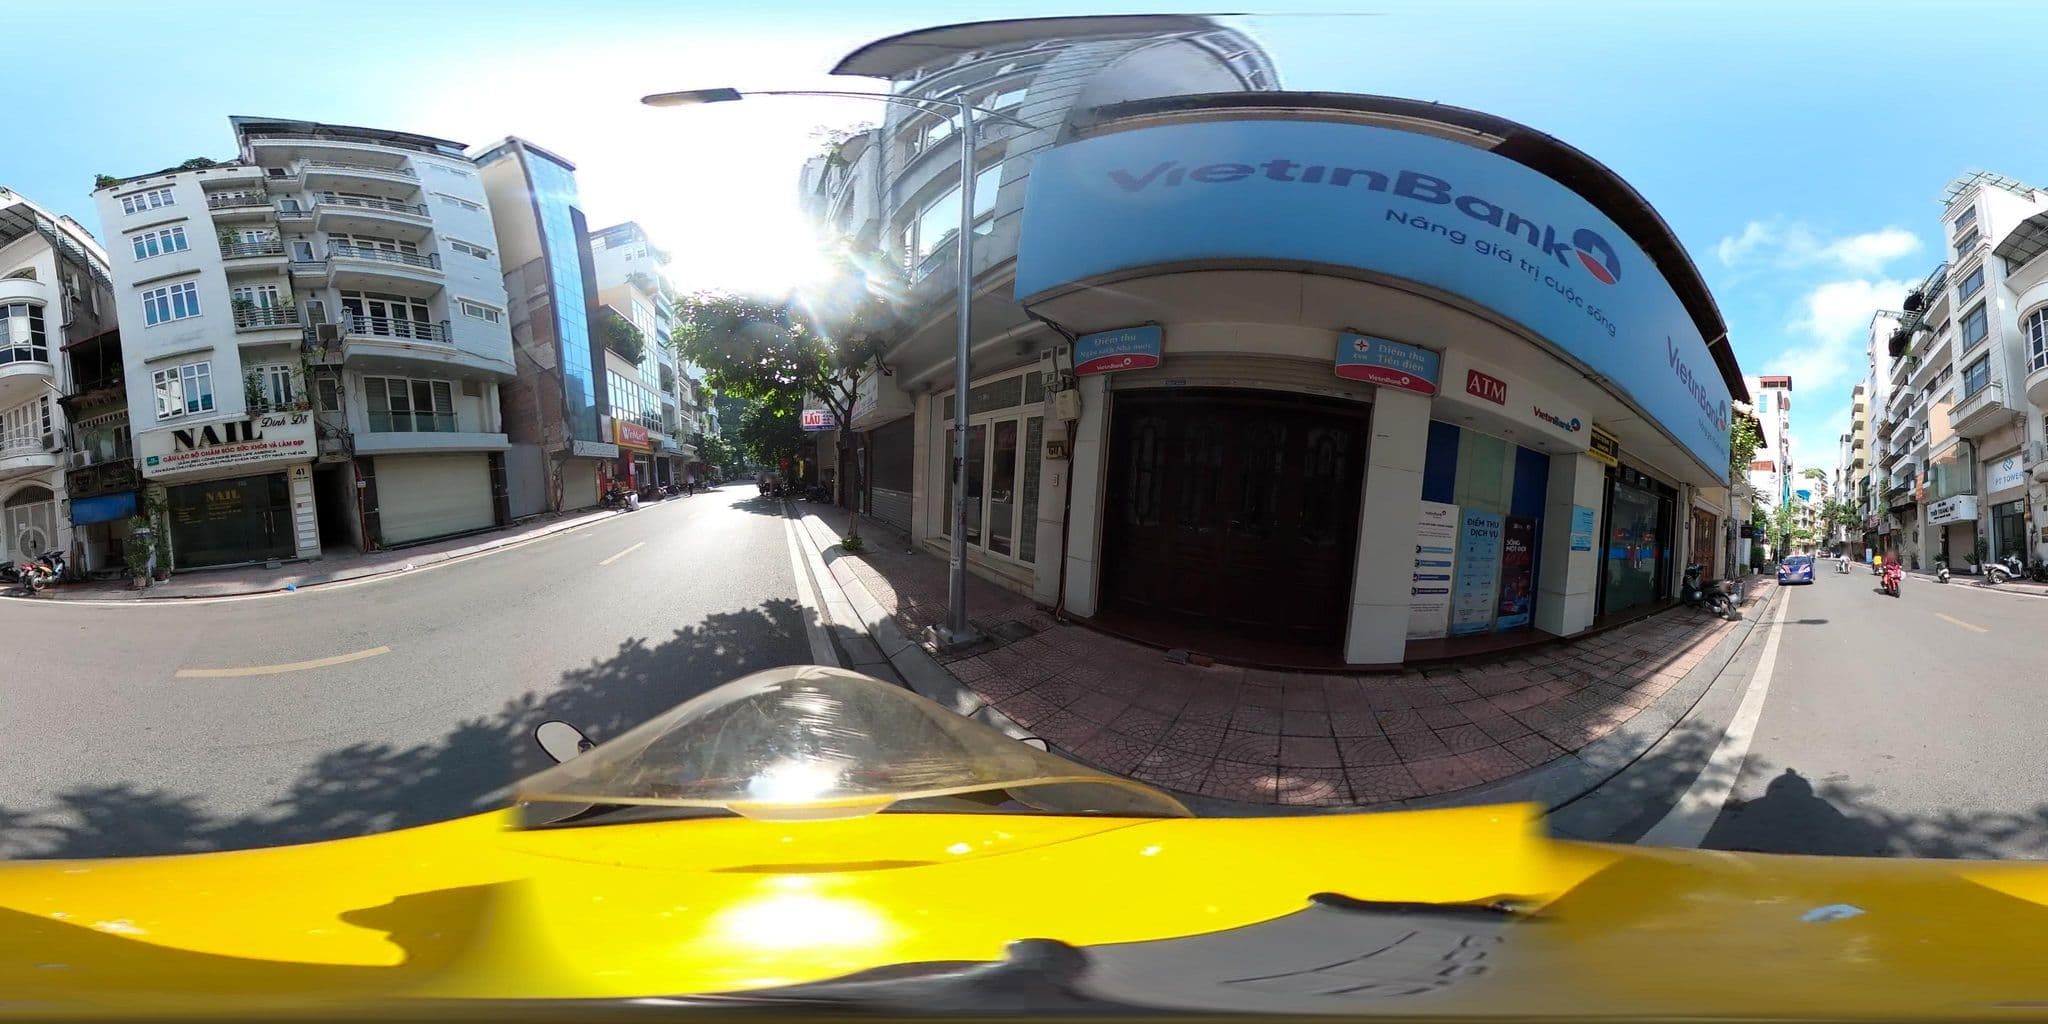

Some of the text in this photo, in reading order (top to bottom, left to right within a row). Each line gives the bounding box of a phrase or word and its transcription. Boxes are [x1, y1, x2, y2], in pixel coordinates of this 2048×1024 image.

[1107, 158, 1577, 267] VietinBank
[1385, 209, 1617, 337] Nâng giá trị cuộc sống
[1408, 351, 1425, 362] thu
[1469, 375, 1504, 401] ATM
[1667, 336, 1720, 431] VietinBank
[1533, 406, 1573, 432] VietinBank
[171, 421, 263, 450] NAIL
[206, 489, 240, 501] NAIL
[1466, 516, 1485, 528] ĐIỂM
[1487, 520, 1500, 529] THU
[1470, 528, 1488, 538] DỊCH
